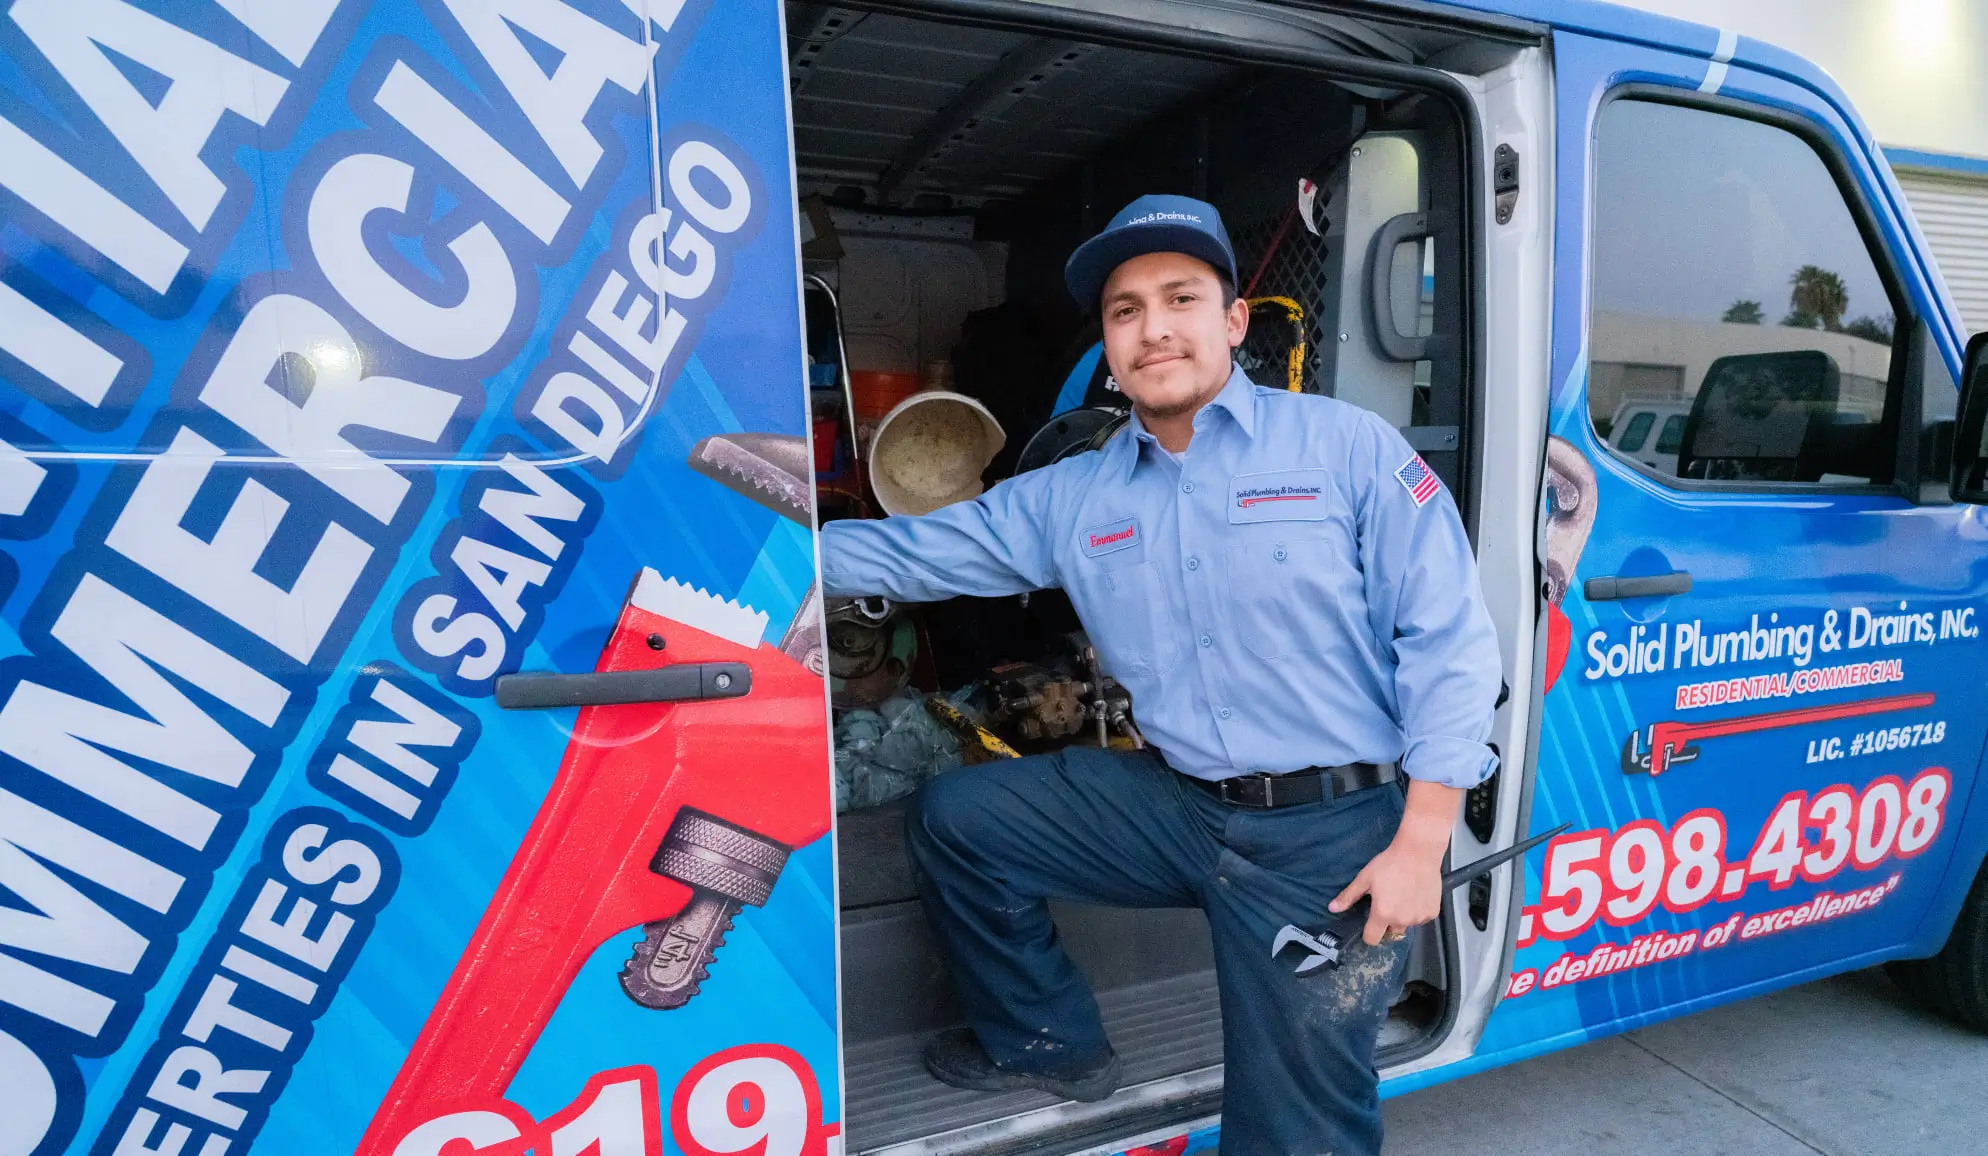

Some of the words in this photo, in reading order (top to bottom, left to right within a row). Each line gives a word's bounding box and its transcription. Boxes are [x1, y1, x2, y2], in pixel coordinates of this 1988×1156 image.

[1148, 213, 1155, 221] &
[327, 678, 463, 821] IN
[412, 452, 586, 681] SAN
[530, 140, 752, 465] DIEGO
[1236, 489, 1251, 498] Solid
[1251, 487, 1280, 497] Plumbing
[1281, 486, 1287, 495] &
[1090, 525, 1134, 548] Emmanuel
[0, 0, 687, 1156] MMERCIA
[1585, 622, 1667, 680] Solid
[1674, 612, 1814, 666] Plumbing
[1819, 609, 1842, 653] &
[1848, 600, 1936, 646] Drains,
[1940, 607, 1979, 639] INC.
[1676, 659, 1904, 710] RESIDENTIAL/COMMERCIAL
[1806, 737, 1844, 764] LIC.
[1850, 721, 1947, 757] #1056718
[1543, 932, 1697, 988] definition
[1703, 915, 1741, 947] of
